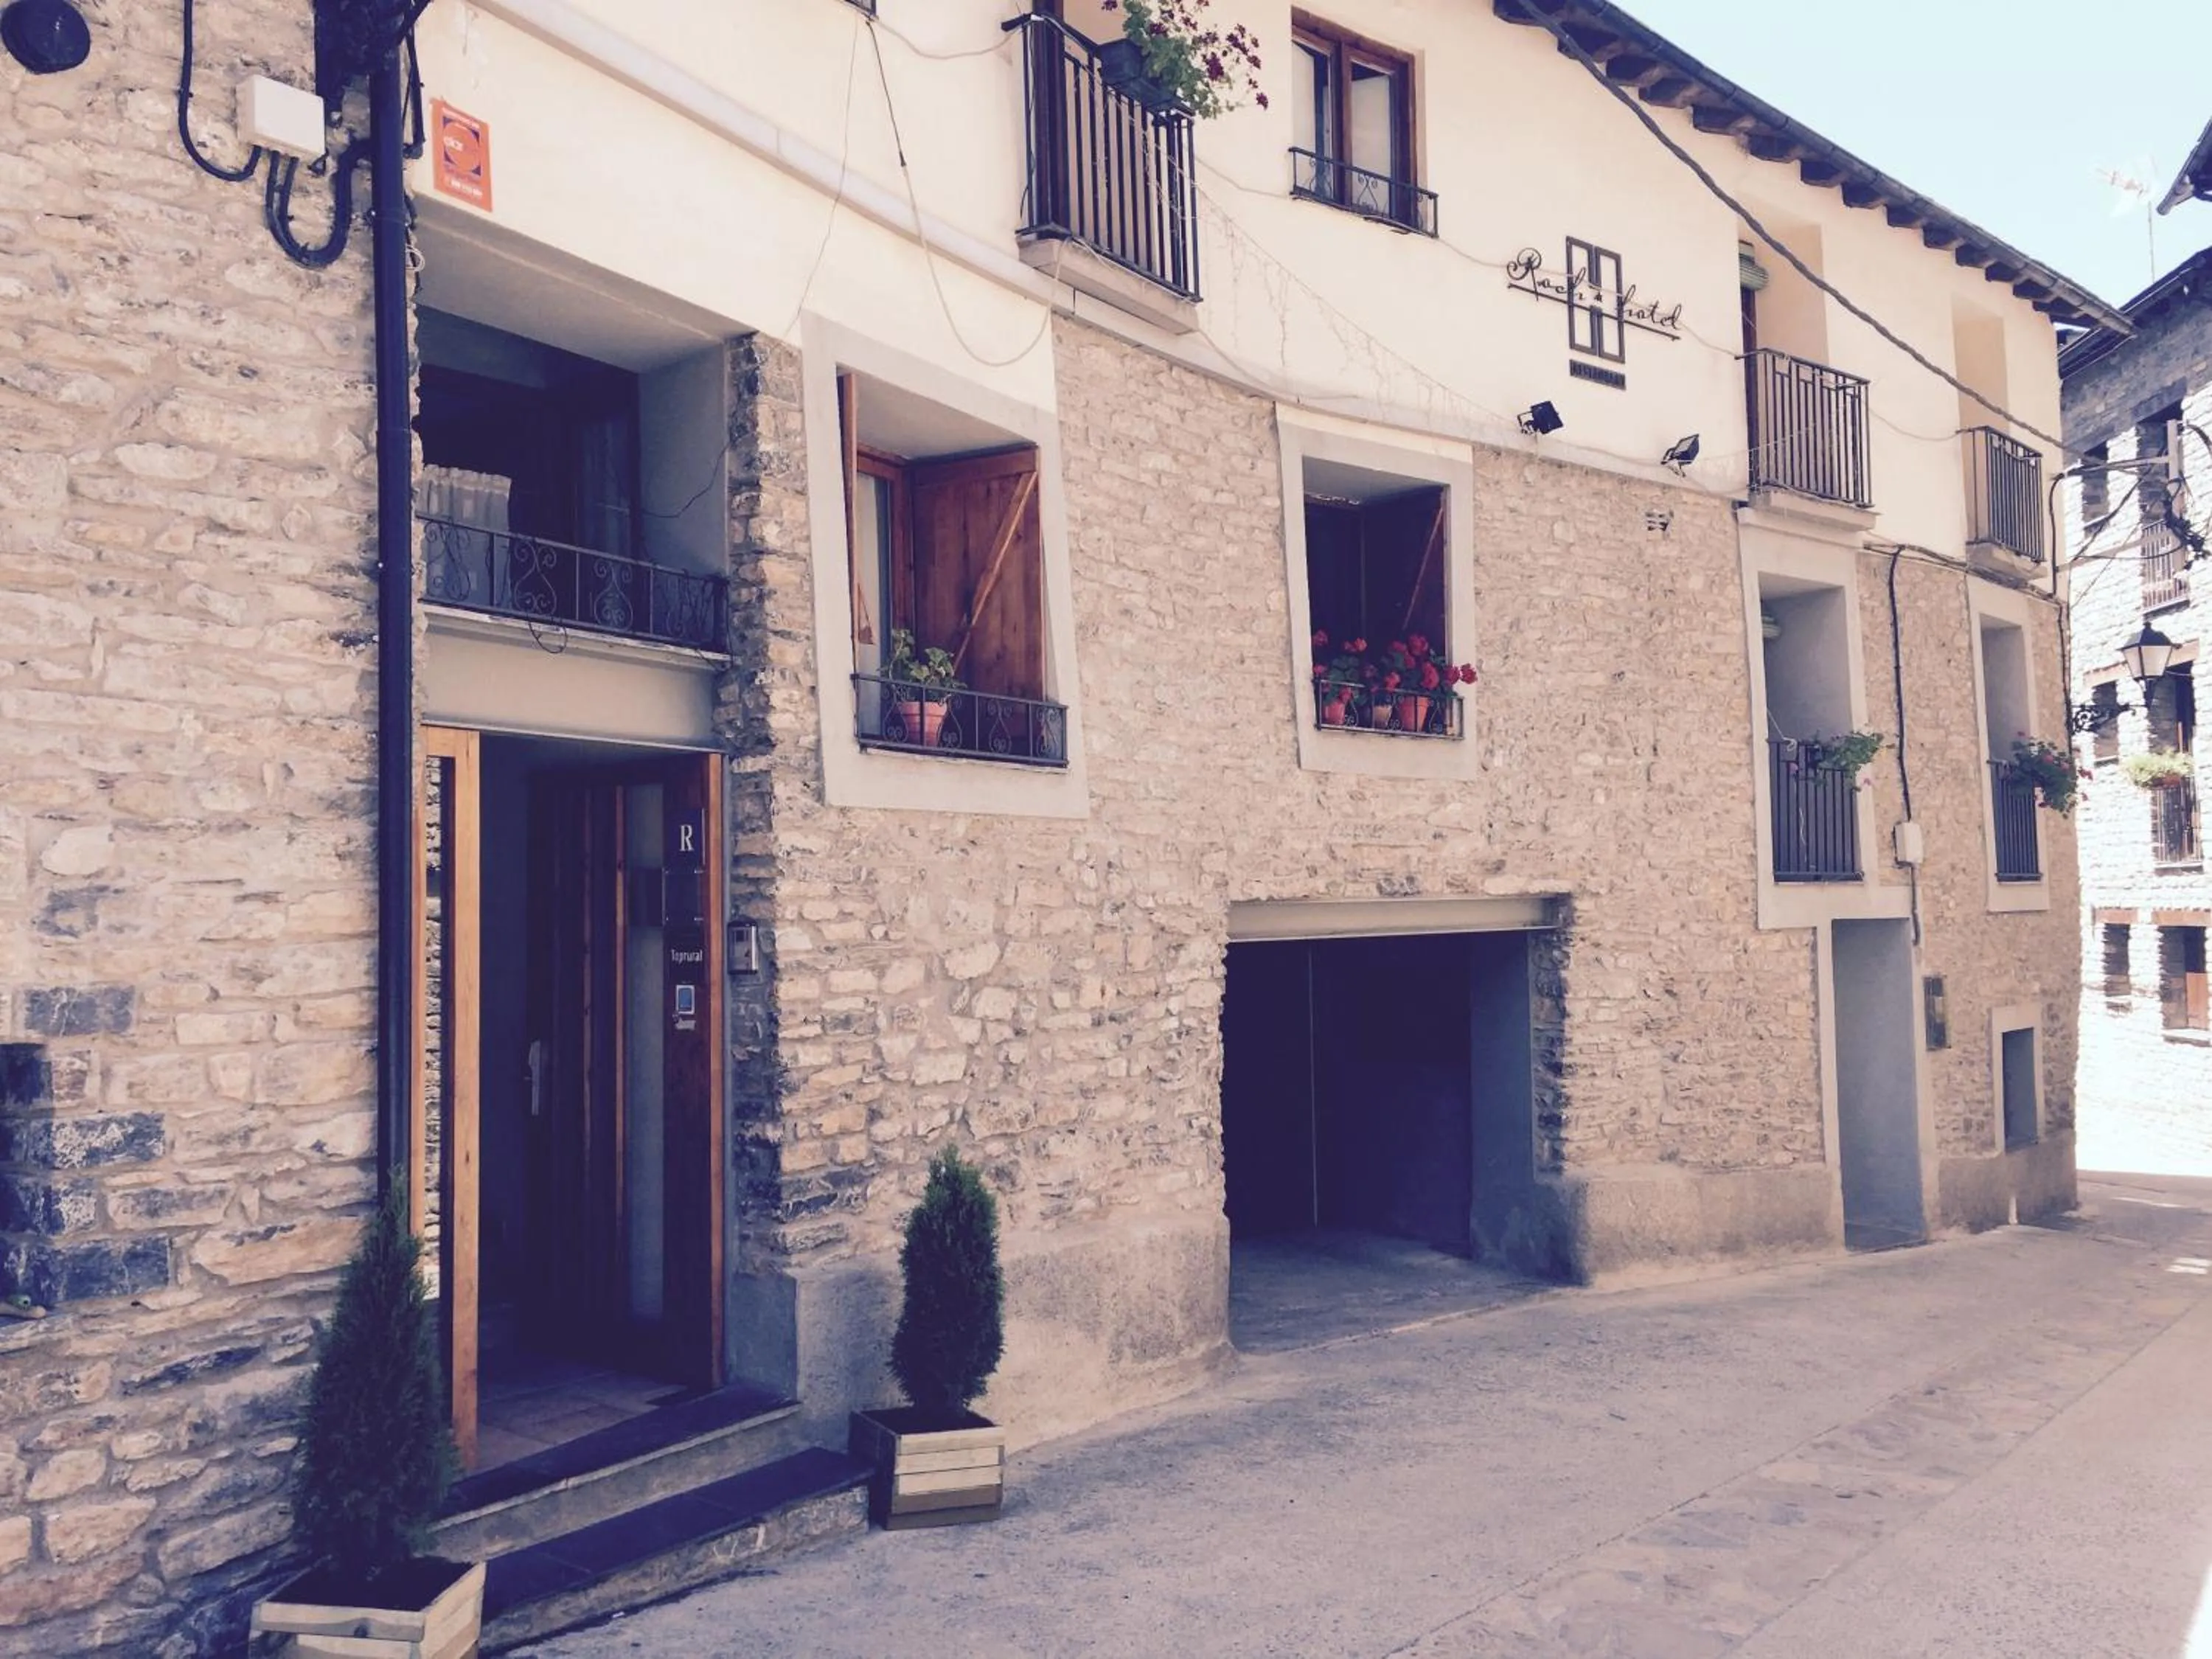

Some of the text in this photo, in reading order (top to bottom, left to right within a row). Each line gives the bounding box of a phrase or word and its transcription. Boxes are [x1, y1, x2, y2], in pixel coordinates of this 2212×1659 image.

[1617, 285, 1682, 330] hotel
[679, 824, 695, 852] R
[671, 948, 703, 965] Toprural
